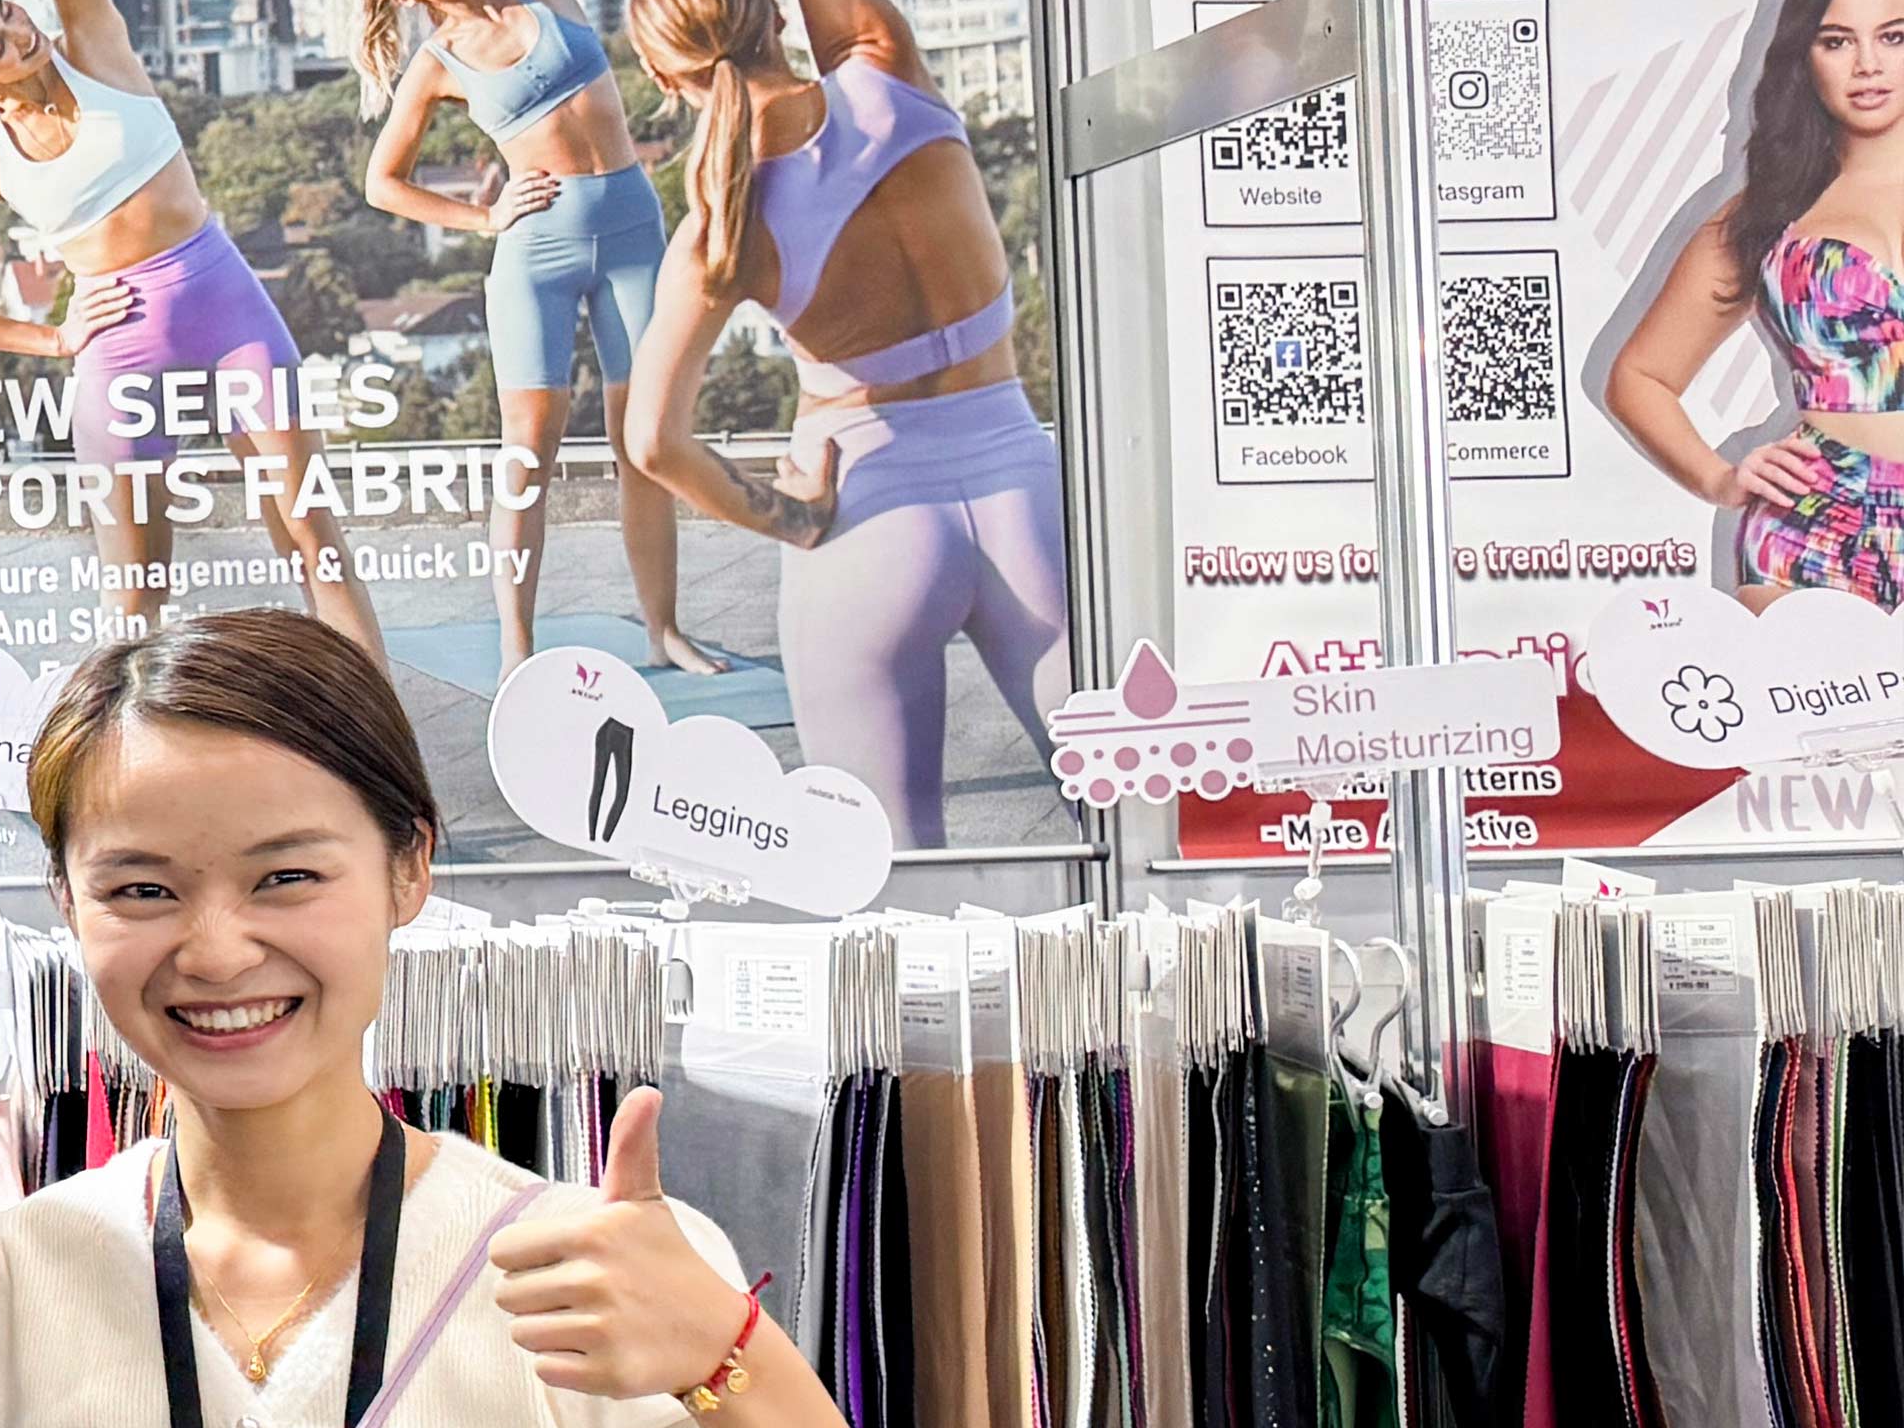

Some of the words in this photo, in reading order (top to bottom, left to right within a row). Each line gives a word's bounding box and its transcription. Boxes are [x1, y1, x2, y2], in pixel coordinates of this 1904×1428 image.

[1238, 186, 1323, 206] Website
[107, 363, 401, 440] SERIES
[1241, 444, 1348, 465] Facebook
[243, 446, 542, 521] FABRIC
[71, 549, 305, 592] Management
[315, 545, 343, 584] &
[354, 544, 459, 583] Quick
[469, 540, 533, 586] Dry
[1184, 545, 1288, 578] Follow
[1293, 548, 1333, 577] us
[1483, 541, 1570, 575] trend
[1577, 538, 1697, 581] reports
[69, 604, 149, 643] Skin
[1292, 684, 1377, 718] Skin
[1768, 675, 1872, 716] Digital
[1296, 721, 1534, 768] Moisturizing
[652, 784, 790, 850] Leggings
[1736, 773, 1874, 833] NEW
